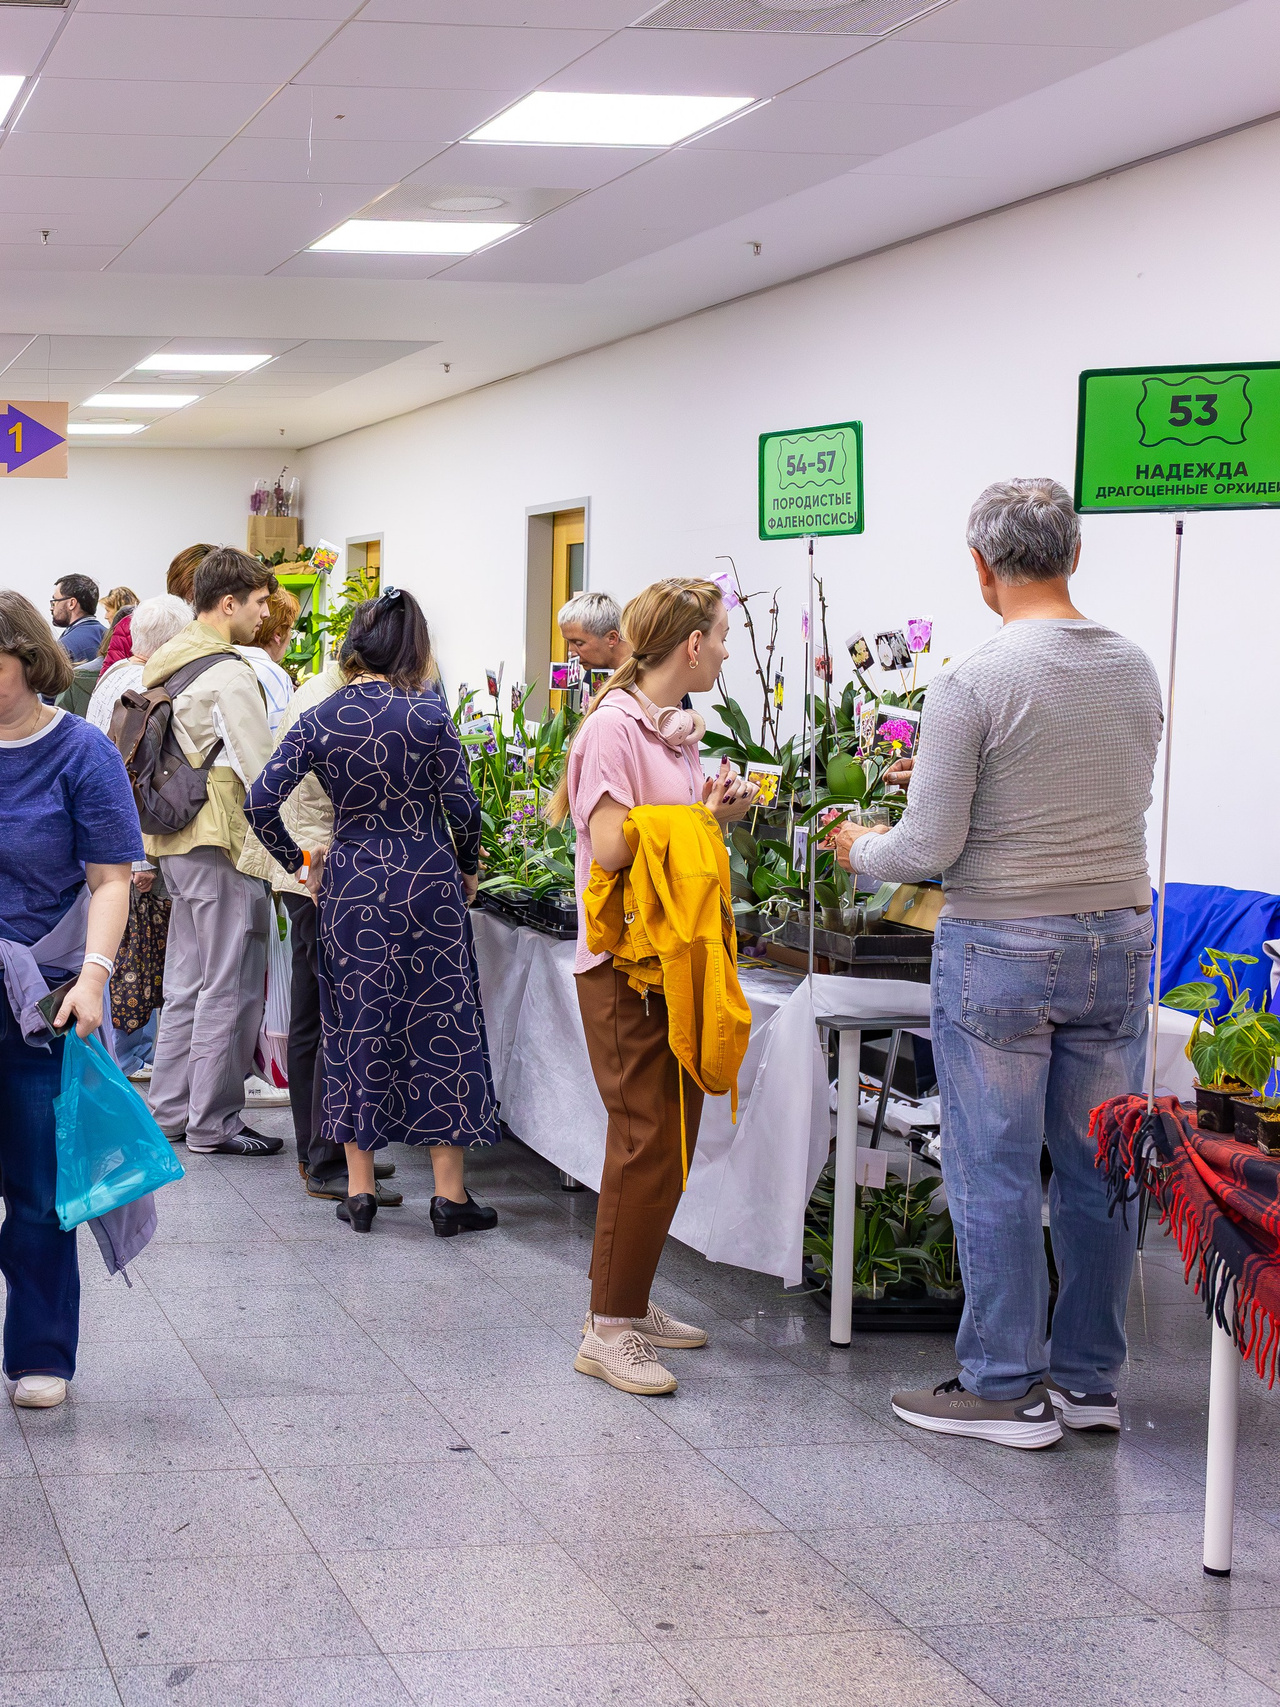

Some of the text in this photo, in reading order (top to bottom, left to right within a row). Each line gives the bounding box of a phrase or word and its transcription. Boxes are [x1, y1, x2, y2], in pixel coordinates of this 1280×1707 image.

[1168, 393, 1218, 427] 53
[8, 422, 23, 453] 1
[786, 450, 836, 476] 54-57
[1136, 461, 1249, 482] НАДЕЖДА
[773, 492, 852, 511] ПОРОДИСТЫЕ
[1095, 483, 1208, 499] ДРАГОЦЕННЫЕ
[767, 511, 857, 530] ФАЛЕНОПСИСЫ
